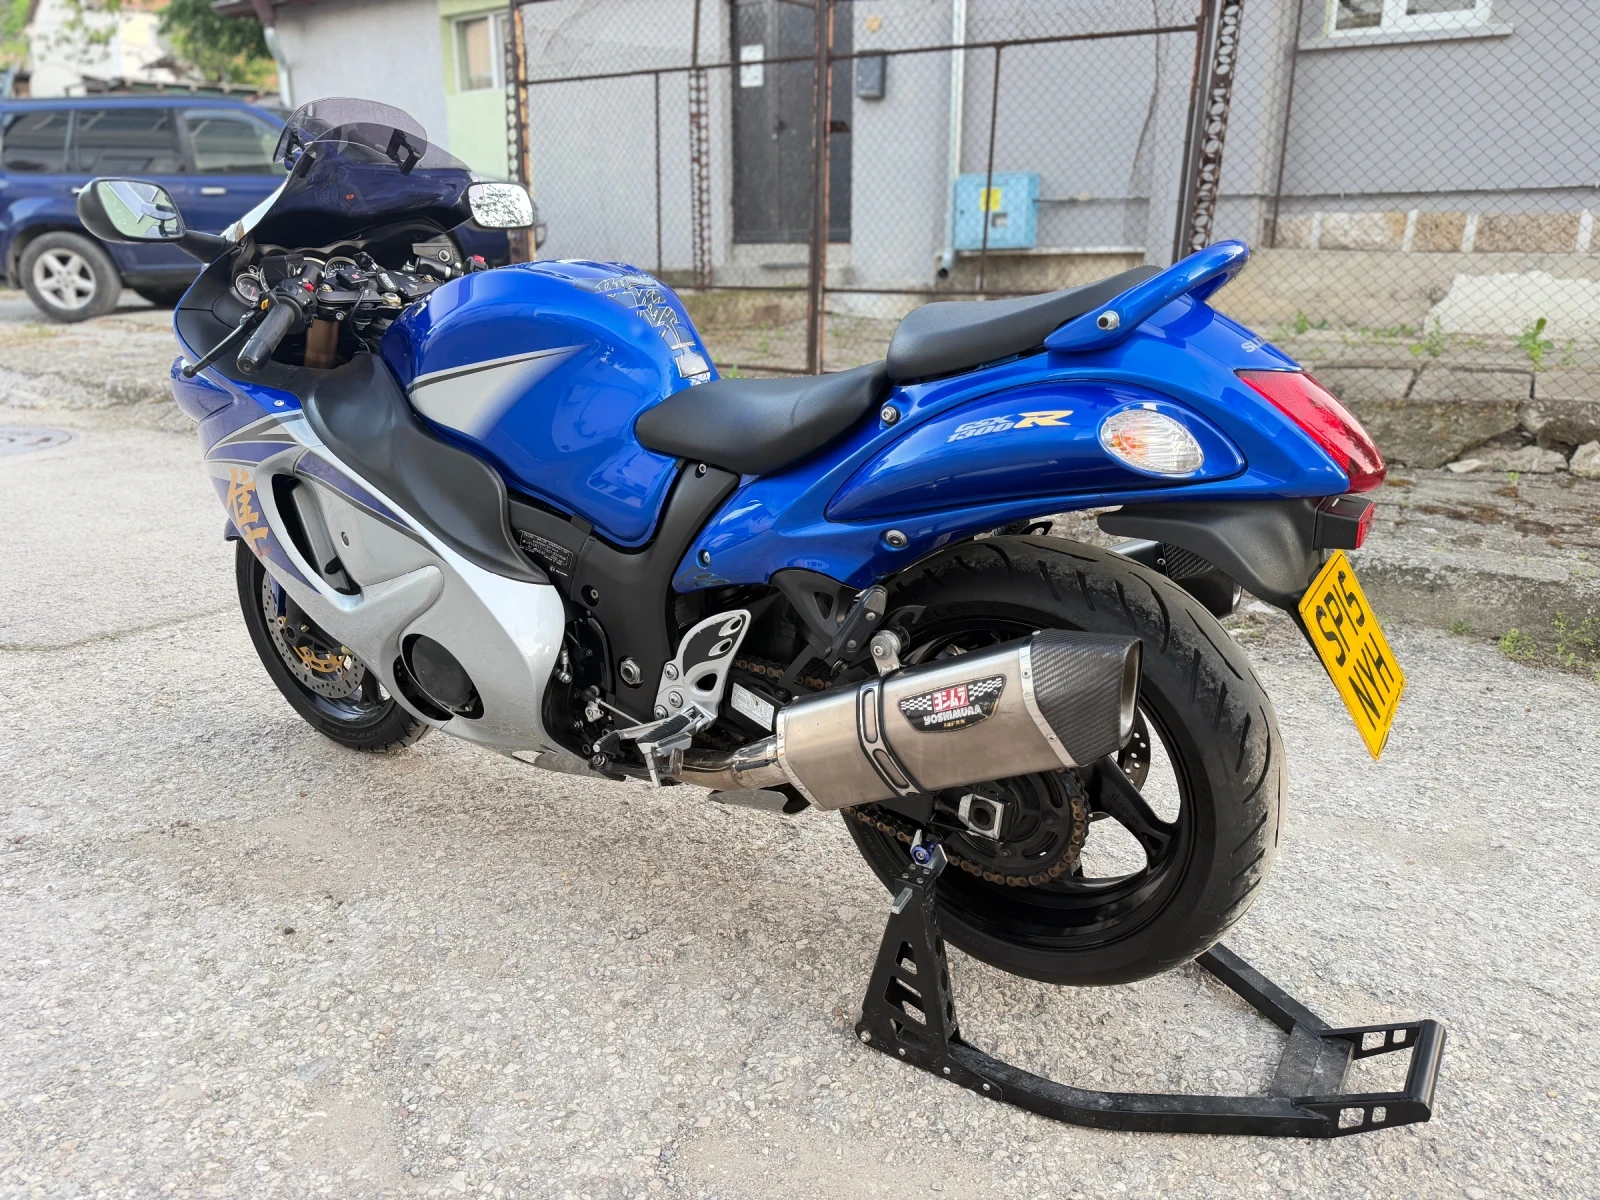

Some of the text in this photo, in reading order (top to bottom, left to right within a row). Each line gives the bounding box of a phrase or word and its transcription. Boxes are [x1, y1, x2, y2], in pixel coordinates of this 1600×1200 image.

[1013, 410, 1074, 429] R
[947, 422, 1015, 443] 1300
[1348, 631, 1395, 732] NYH
[923, 704, 983, 726] YOSHIMURA
